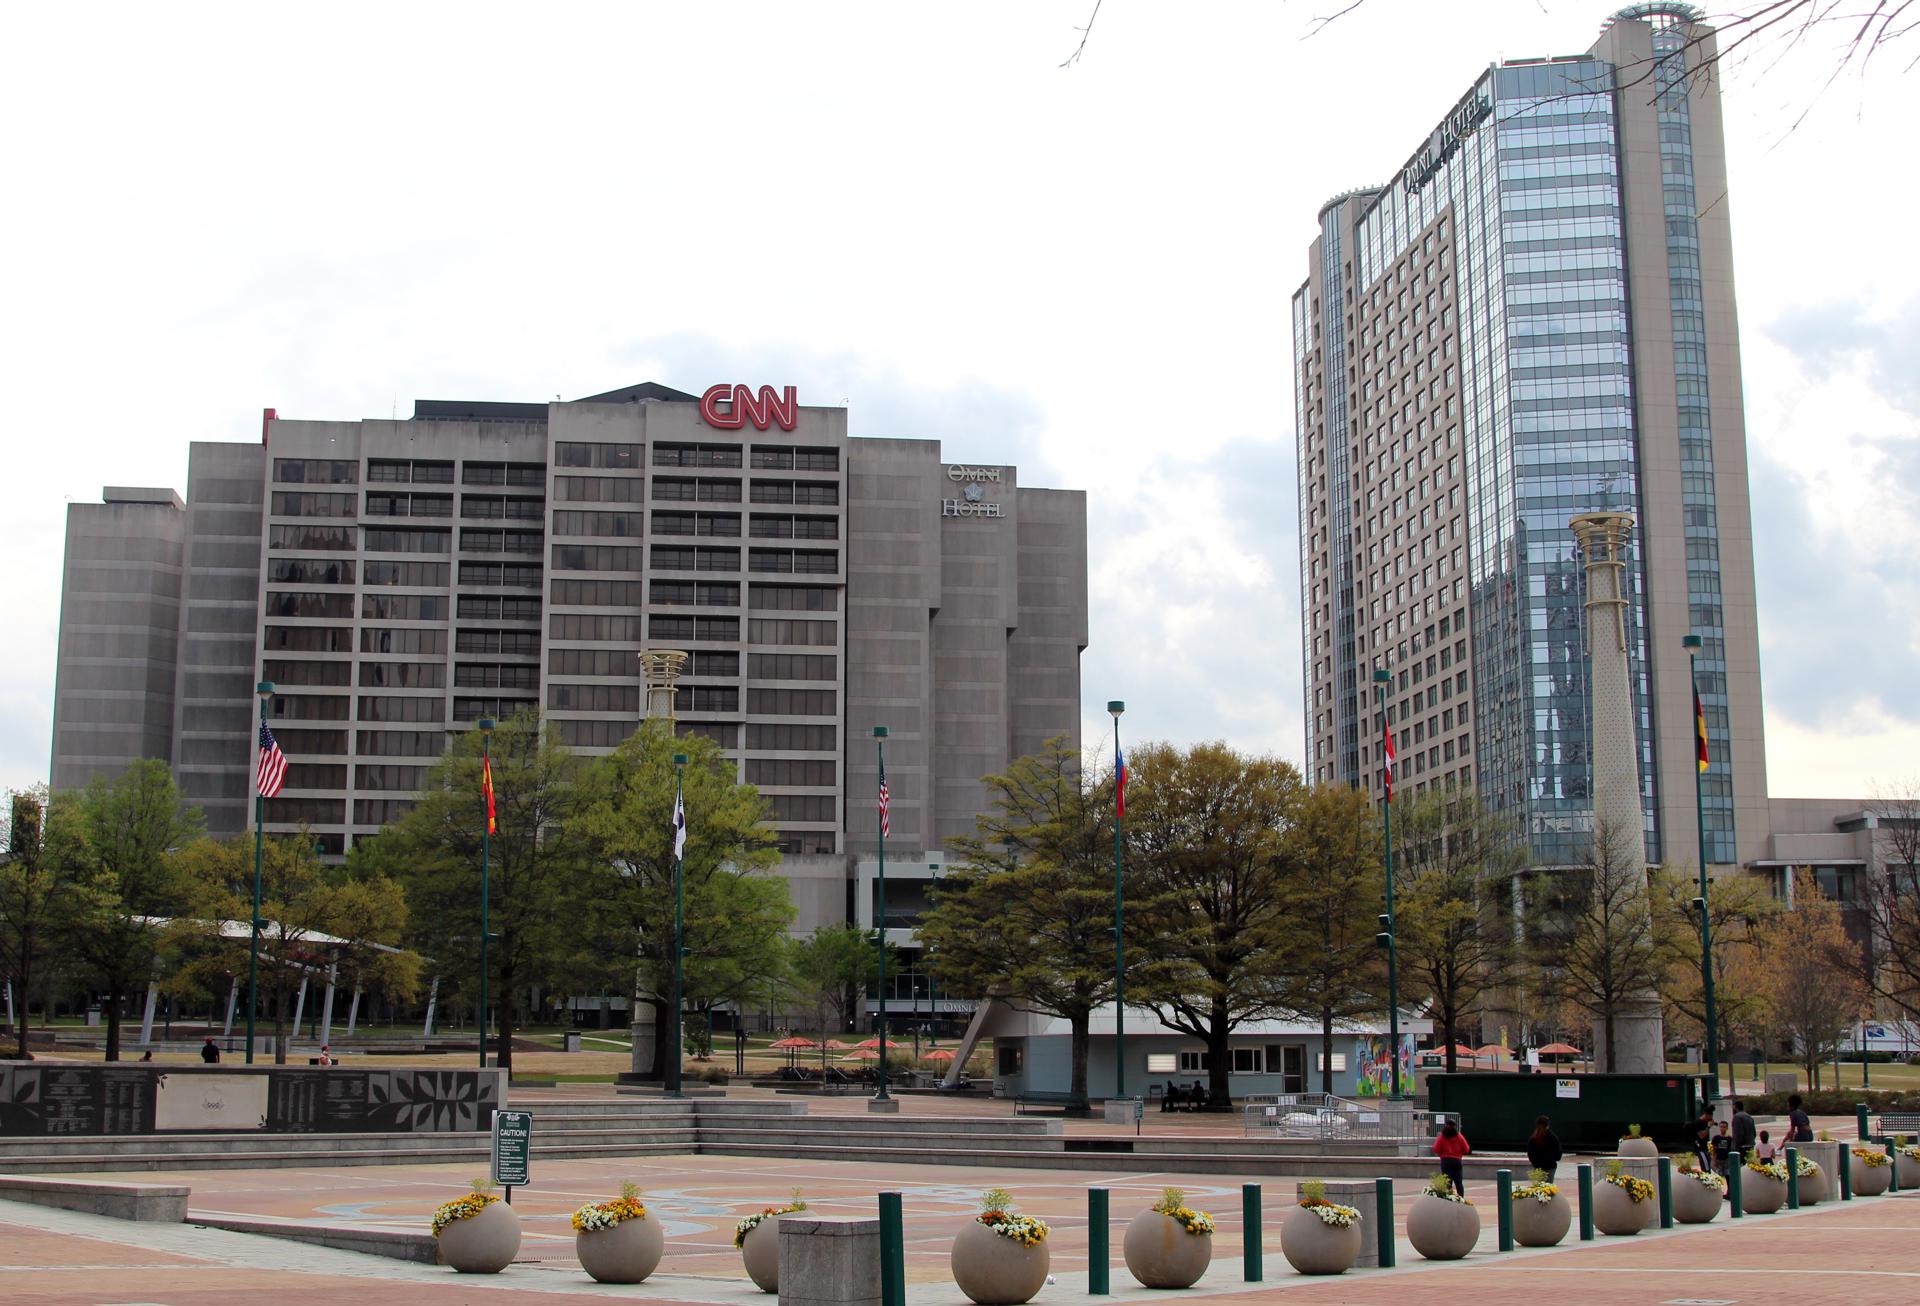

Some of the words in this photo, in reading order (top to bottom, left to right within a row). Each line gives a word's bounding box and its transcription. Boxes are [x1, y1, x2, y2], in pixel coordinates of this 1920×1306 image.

[1402, 148, 1431, 193] OMNI
[1442, 97, 1480, 151] HOTEL
[699, 384, 798, 431] CNN
[947, 464, 1001, 482] OMNI
[942, 498, 1006, 518] HOTEL
[943, 1002, 971, 1013] OMNI
[500, 1128, 527, 1137] CAUTION!
